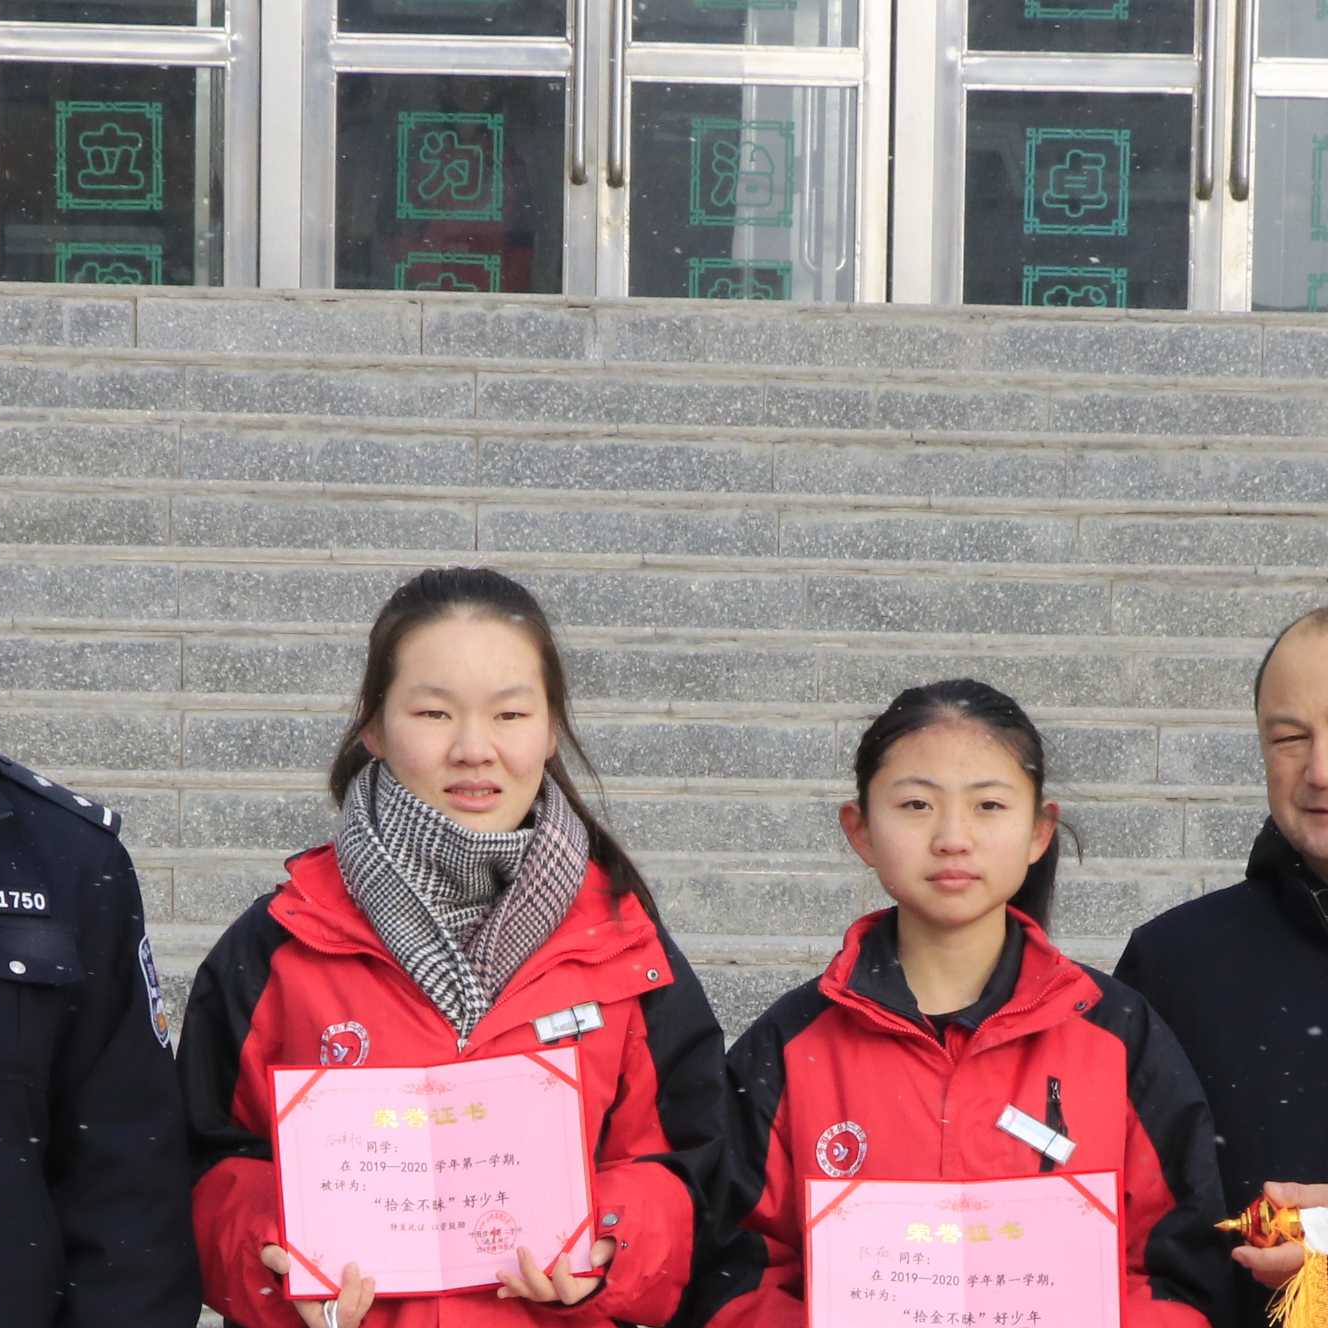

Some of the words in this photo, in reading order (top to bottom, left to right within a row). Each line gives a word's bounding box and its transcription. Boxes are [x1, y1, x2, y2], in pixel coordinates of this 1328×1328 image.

[78, 123, 144, 189] 立
[372, 1102, 488, 1129] 荣誉证书
[340, 1160, 353, 1172] 在
[905, 1221, 1024, 1244] 荣誉证书
[871, 1269, 883, 1281] 在
